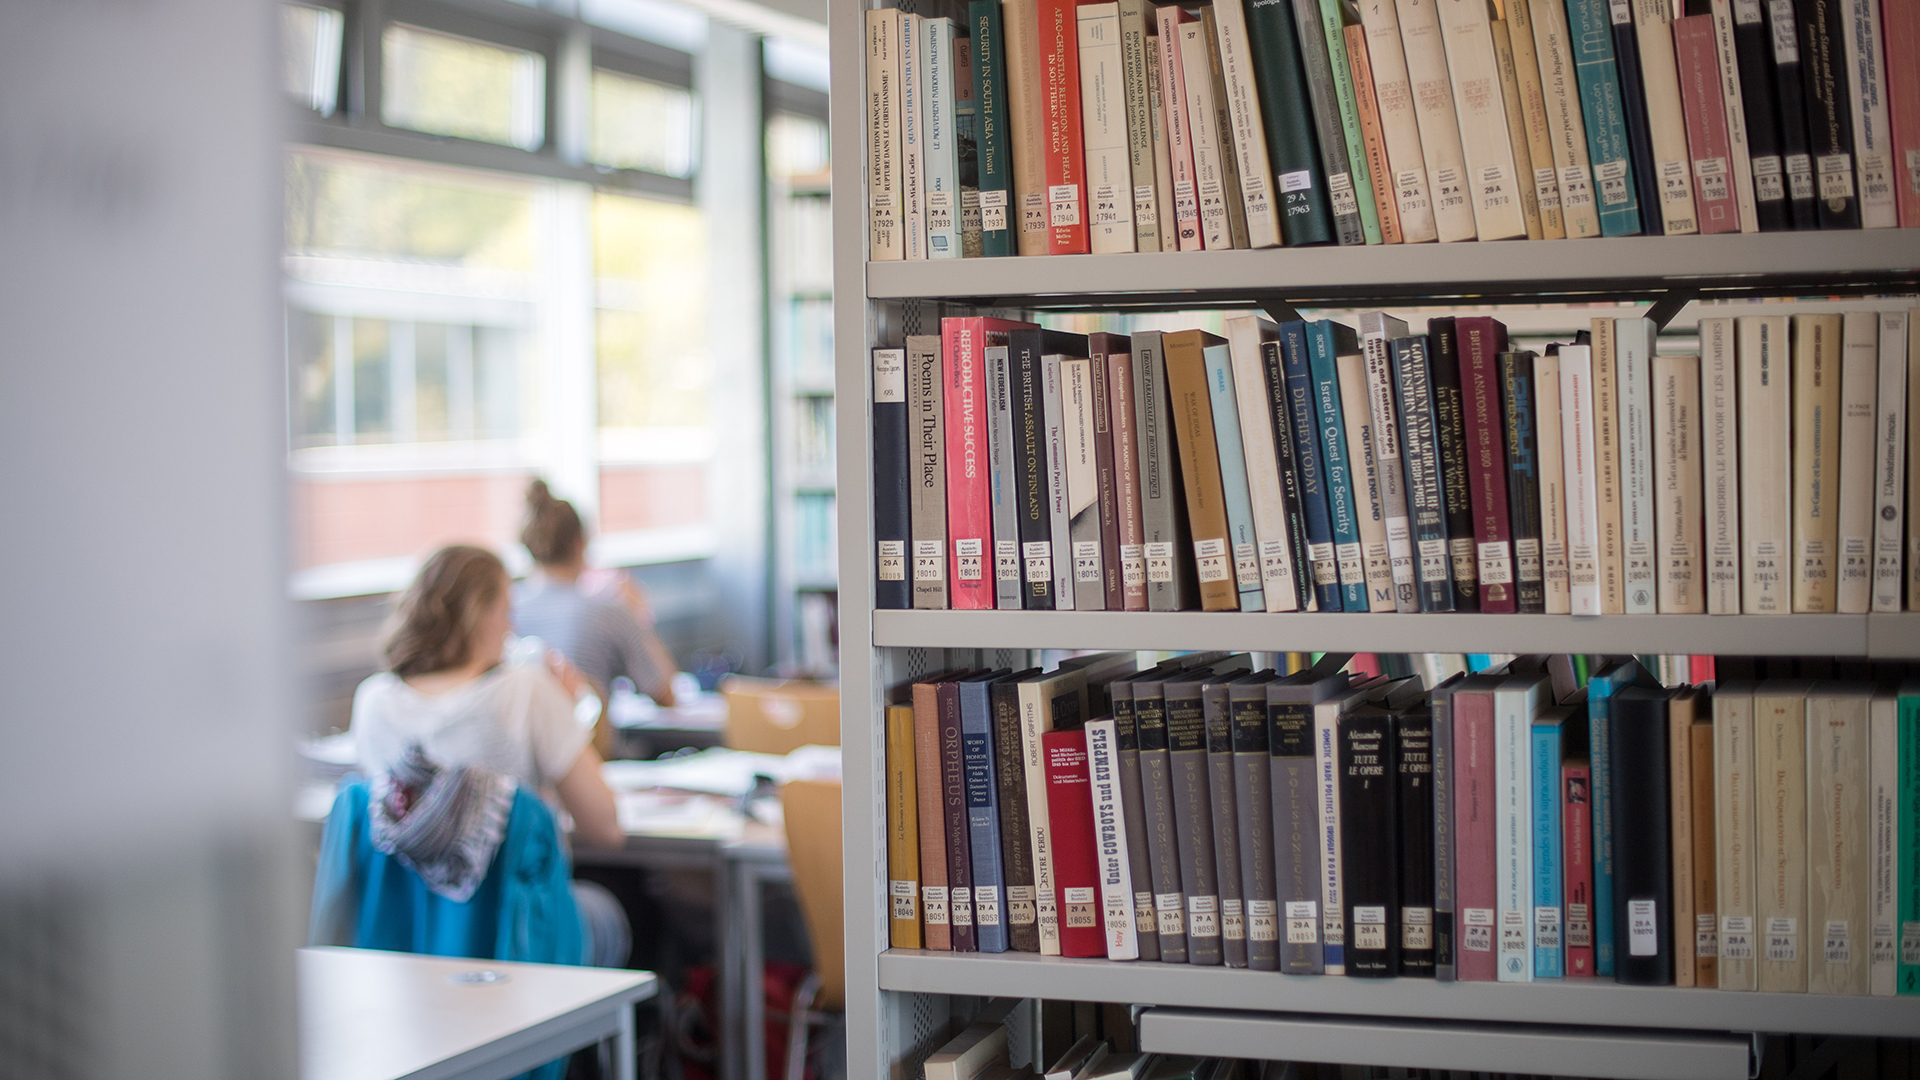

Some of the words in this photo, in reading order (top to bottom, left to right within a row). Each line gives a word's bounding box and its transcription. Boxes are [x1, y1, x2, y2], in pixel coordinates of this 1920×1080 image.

[903, 16, 911, 47] GUERRE
[929, 23, 937, 64] PALESTINIEN
[979, 15, 990, 62] SECURITY
[1053, 7, 1065, 84] AFRO-CHRISTIAN
[1132, 31, 1140, 47] KING
[1224, 37, 1232, 53] SIGLO
[981, 65, 991, 77] IN
[1047, 54, 1055, 64] IN
[1133, 49, 1142, 77] HUSSEIN
[982, 79, 992, 113] SOUTH
[1048, 66, 1058, 117] SOUTHERN
[1135, 79, 1143, 94] AND
[1230, 74, 1239, 97] NEGROS
[881, 75, 889, 127] CHRISTIANISME
[1057, 87, 1067, 130] RELIGION
[1234, 98, 1244, 127] ESCLAVOS
[907, 116, 915, 144] QUAND
[931, 100, 940, 140] MOUVEMENT
[984, 116, 993, 139] ASIA
[1137, 109, 1148, 148] CHALLENGE
[1050, 120, 1060, 153] AFRICA
[1060, 134, 1069, 154] AND
[873, 130, 881, 175] RÉVOLUTION
[985, 146, 995, 174] Tiwari
[883, 159, 891, 190] RUPTURE
[1287, 195, 1296, 203] 29
[1299, 193, 1306, 201] A
[1287, 205, 1310, 216] 17963
[1020, 348, 1030, 369] THE
[1287, 332, 1300, 364] Rickman
[1315, 334, 1325, 358] SICKER
[1374, 338, 1385, 365] Russia
[1398, 349, 1411, 360] IN
[1469, 330, 1481, 369] BRITISH
[921, 353, 936, 396] Poems
[952, 344, 961, 388] Clutton-Brock
[960, 330, 973, 423] REPRODUCTIVE
[1378, 368, 1387, 384] and
[1409, 343, 1429, 414] GOVERNMENT
[997, 373, 1005, 411] FEDERALISM
[1021, 371, 1032, 410] BRITISH
[1270, 367, 1282, 402] BOTTOM
[1399, 362, 1416, 413] WESTERN
[1713, 374, 1723, 391] LES
[922, 400, 936, 411] in
[1144, 378, 1154, 421] PARADOXALE
[1319, 380, 1336, 423] Israel's
[1380, 387, 1392, 420] eastern
[1438, 401, 1450, 420] the
[1449, 388, 1463, 434] London
[1473, 373, 1487, 423] ANATOMY
[1714, 396, 1723, 408] ET
[1275, 404, 1289, 456] TRANSLATION
[1292, 387, 1312, 446] DILTHEY
[1417, 416, 1431, 437] AND
[922, 414, 937, 450] Their
[1024, 412, 1035, 454] ASSAULT
[1323, 426, 1341, 460] Quest
[1383, 423, 1396, 453] Europe
[1404, 415, 1420, 455] EUROPE
[1438, 424, 1452, 447] Age
[1714, 411, 1725, 456] POUVOIR
[963, 425, 975, 478] SUCCESS
[1027, 457, 1036, 472] ON
[1051, 438, 1060, 470] Communist
[1122, 444, 1130, 470] MAKING
[1442, 451, 1454, 463] of
[923, 452, 937, 487] Place
[1052, 471, 1060, 487] Party
[1299, 447, 1318, 494] TODAY
[1330, 466, 1344, 483] for
[1360, 424, 1373, 465] POLITICS
[1367, 478, 1380, 520] ENGLAND
[1420, 441, 1439, 510] AGRICULTURE
[1452, 440, 1470, 509] Newspapers
[1027, 474, 1039, 519] FINLAND
[1054, 496, 1062, 513] Power
[1442, 467, 1459, 514] Walpole
[1331, 486, 1351, 534] Security
[1376, 588, 1391, 602] M
[997, 701, 1010, 754] GILDED
[1026, 702, 1035, 737] GRIFFITHS
[1321, 728, 1330, 758] DOMESTIC
[1348, 730, 1382, 740] Alessandro
[945, 726, 961, 805] ORPHEUS
[1029, 739, 1037, 766] ROBERT
[1091, 728, 1110, 780] KUMPELS
[1354, 756, 1378, 764] TUTTE
[1404, 753, 1428, 762] TUTTE
[1001, 758, 1012, 786] AGE
[1323, 761, 1332, 781] TRADE
[1349, 766, 1358, 775] LE
[1360, 766, 1384, 775] OPERE
[1409, 764, 1432, 773] OPERE
[1097, 782, 1112, 801] und
[1324, 784, 1333, 814] POLITICS
[951, 811, 960, 823] The
[1099, 804, 1117, 855] COWBOYS
[950, 824, 962, 845] Myth
[1036, 826, 1045, 853] PERDU
[1326, 825, 1335, 855] URUGUAY
[1104, 857, 1120, 884] Unter
[1327, 857, 1335, 887] ROUND
[894, 908, 913, 916] 18049
[1070, 916, 1091, 924] 18055
